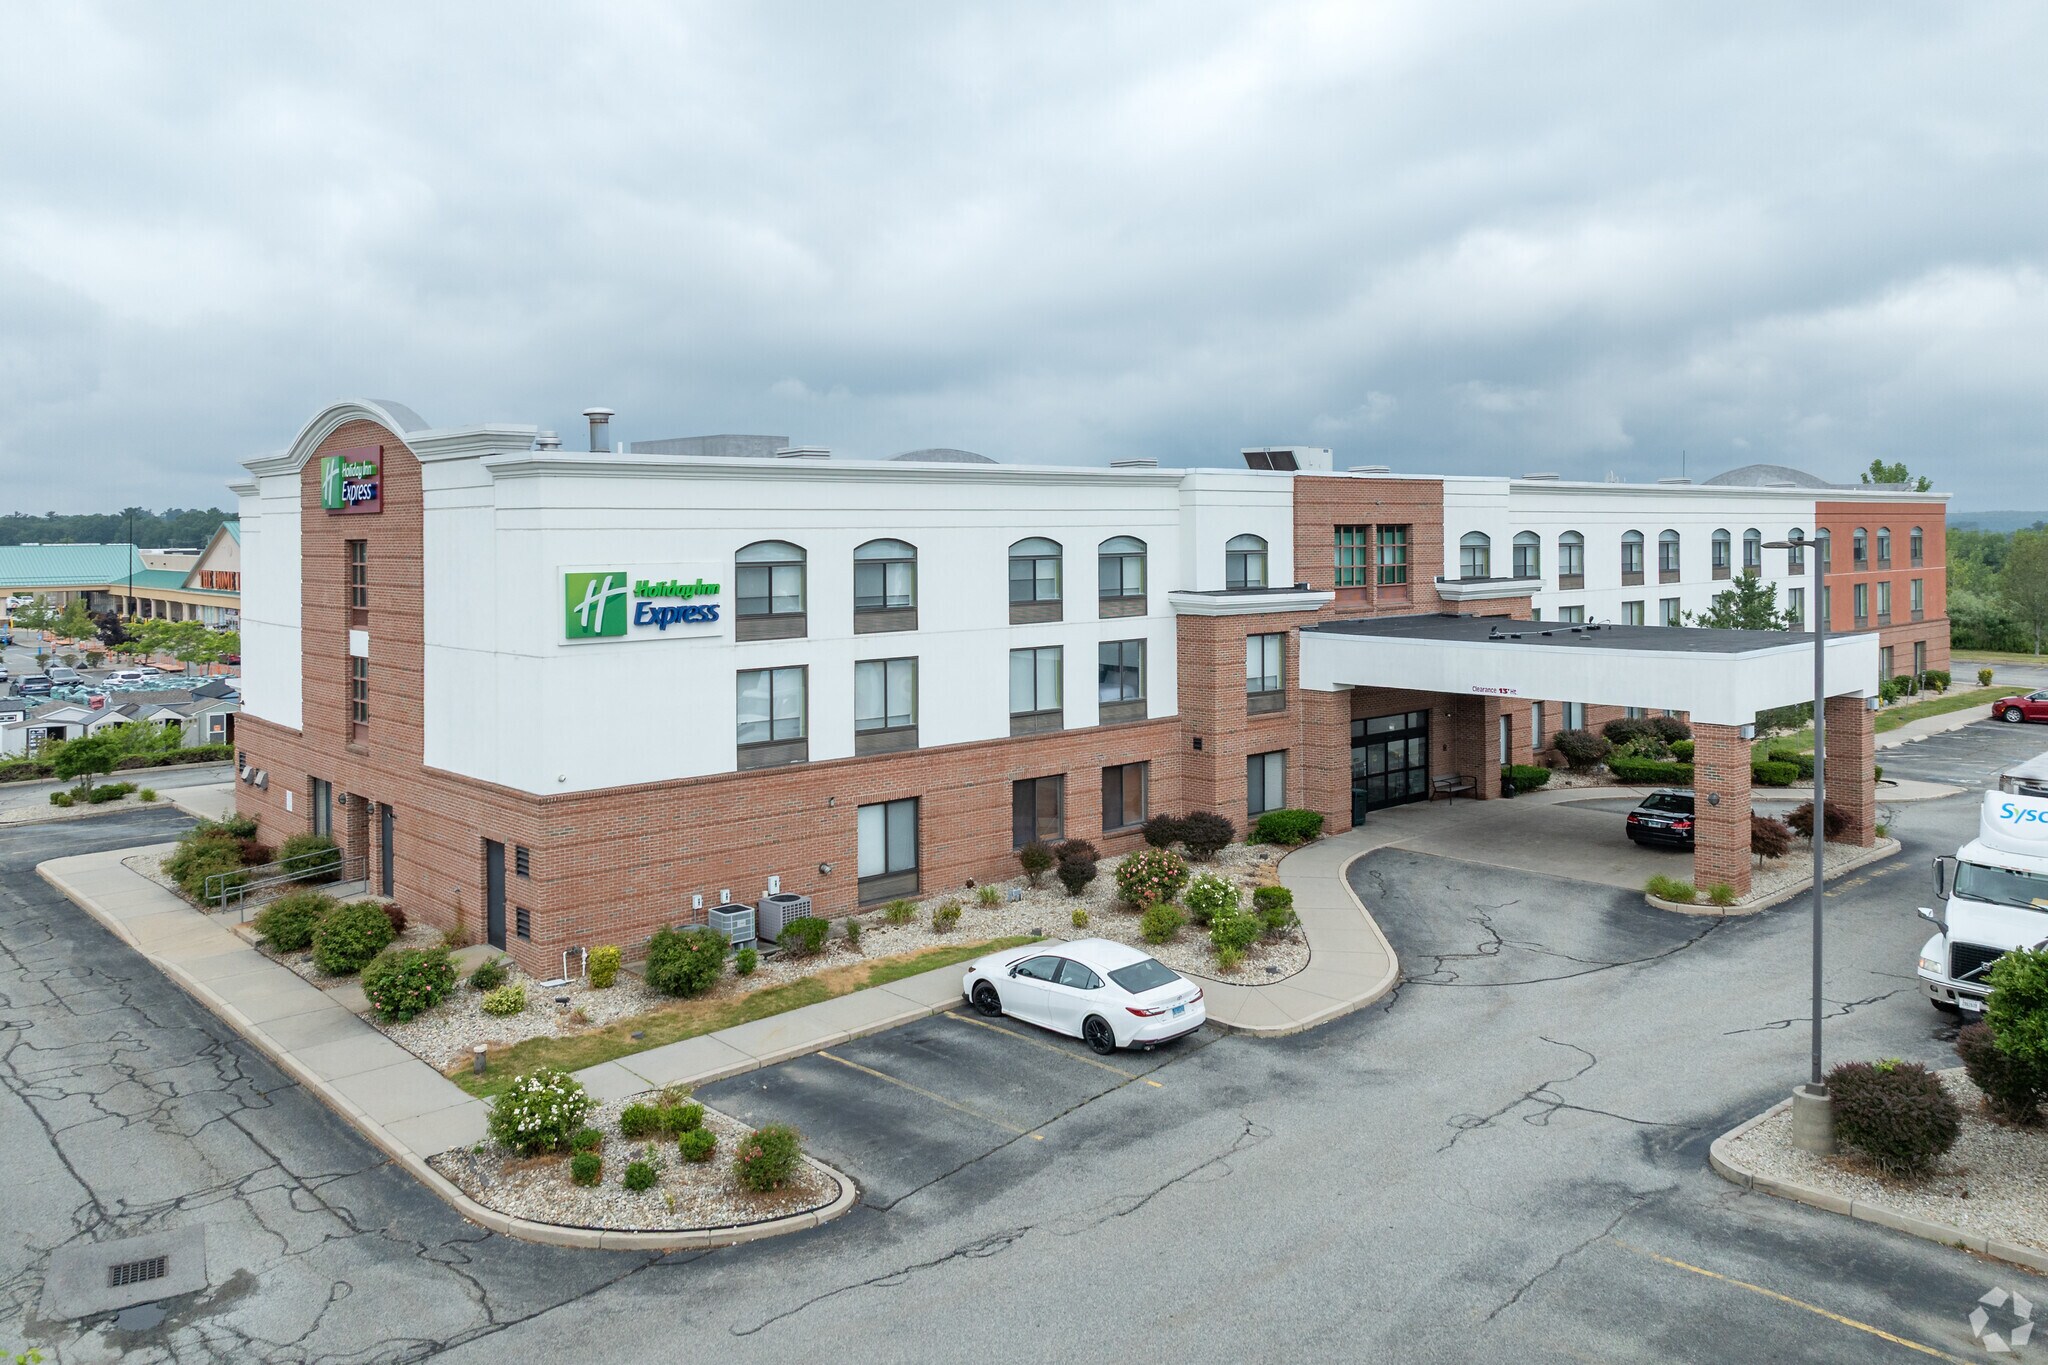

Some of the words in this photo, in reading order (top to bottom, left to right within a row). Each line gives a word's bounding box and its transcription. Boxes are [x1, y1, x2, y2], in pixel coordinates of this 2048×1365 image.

[342, 462, 363, 480] Holiday
[363, 460, 376, 476] Inn
[342, 481, 376, 506] Express
[199, 570, 214, 588] THE
[215, 571, 237, 590] HOME
[633, 579, 697, 600] Holiday
[696, 578, 721, 596] Inn
[633, 602, 721, 631] Express
[1472, 686, 1497, 694] Clearance
